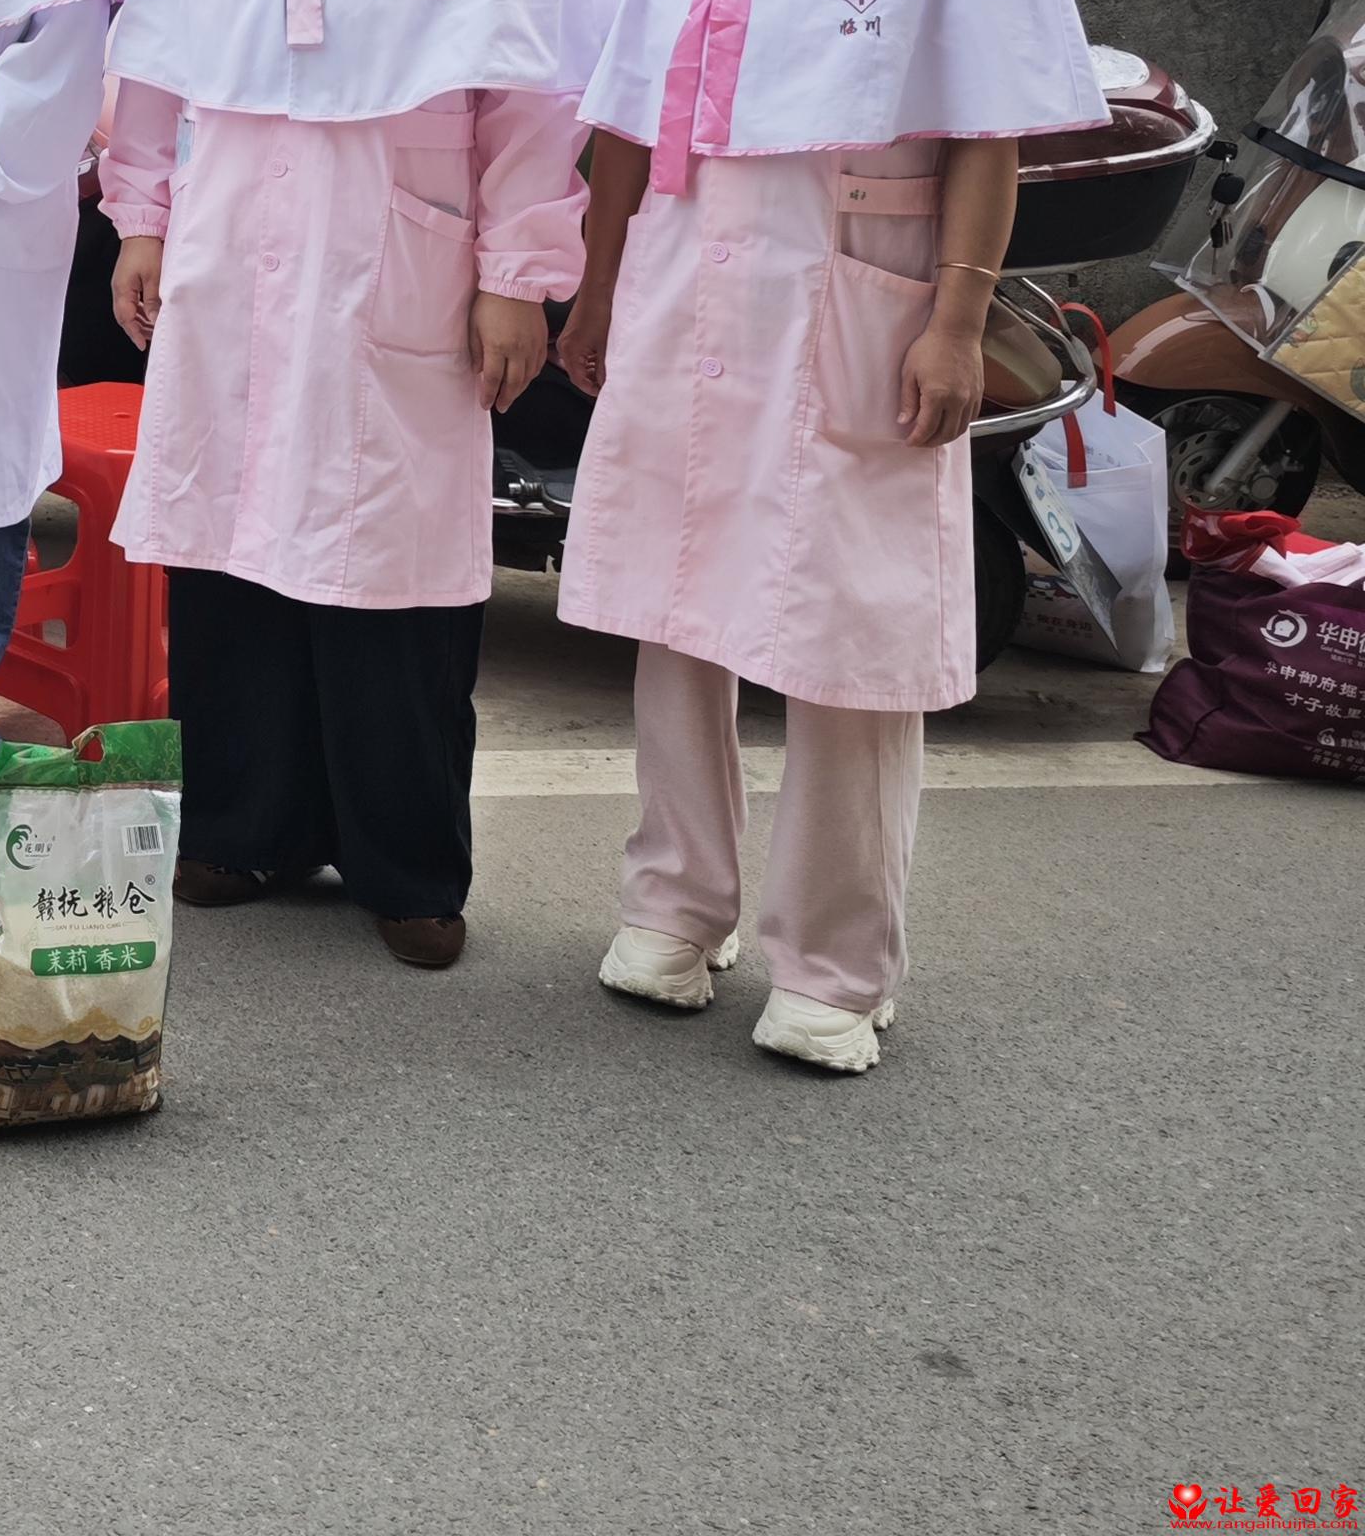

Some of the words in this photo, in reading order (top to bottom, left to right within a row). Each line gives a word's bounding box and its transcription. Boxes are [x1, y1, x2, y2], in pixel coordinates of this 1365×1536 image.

[839, 15, 882, 38] 临川
[32, 881, 156, 921] 赣抚粮仓
[47, 945, 144, 974] 茉莉香米
